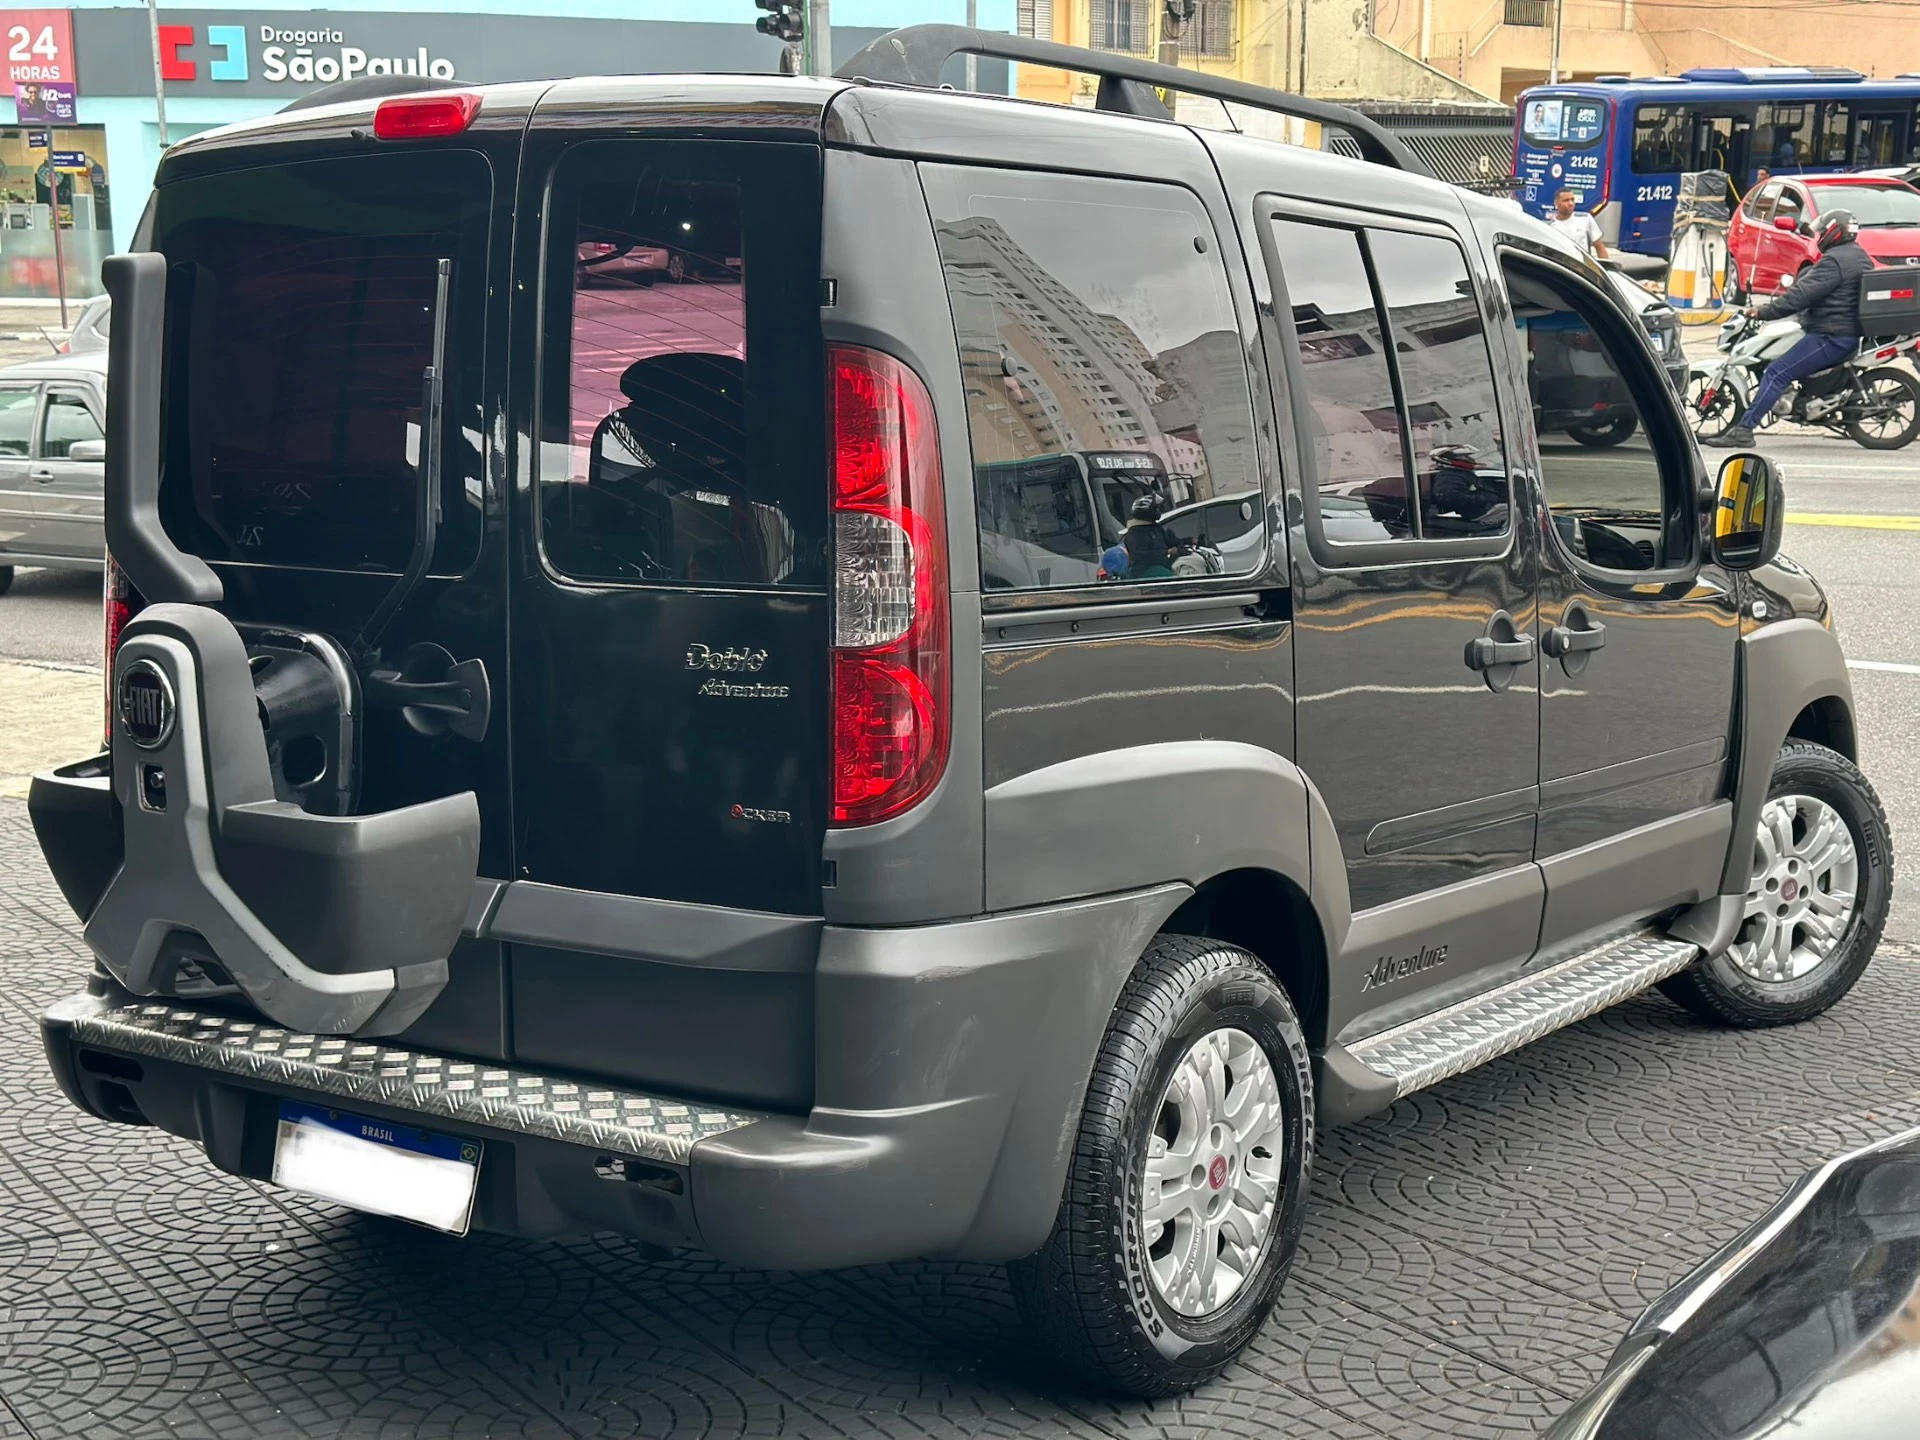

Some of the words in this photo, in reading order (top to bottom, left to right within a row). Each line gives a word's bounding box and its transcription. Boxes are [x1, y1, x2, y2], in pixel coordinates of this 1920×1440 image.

[8, 25, 58, 61] 24
[260, 26, 343, 46] Drogaria
[10, 66, 61, 80] HORAS
[1570, 155, 1599, 169] 21.412
[1637, 184, 1673, 202] 21.412
[130, 685, 160, 727] FIAT
[1361, 944, 1449, 993] Adventure
[1291, 1040, 1314, 1178] PIRELLI
[361, 1124, 395, 1142] BRASIL
